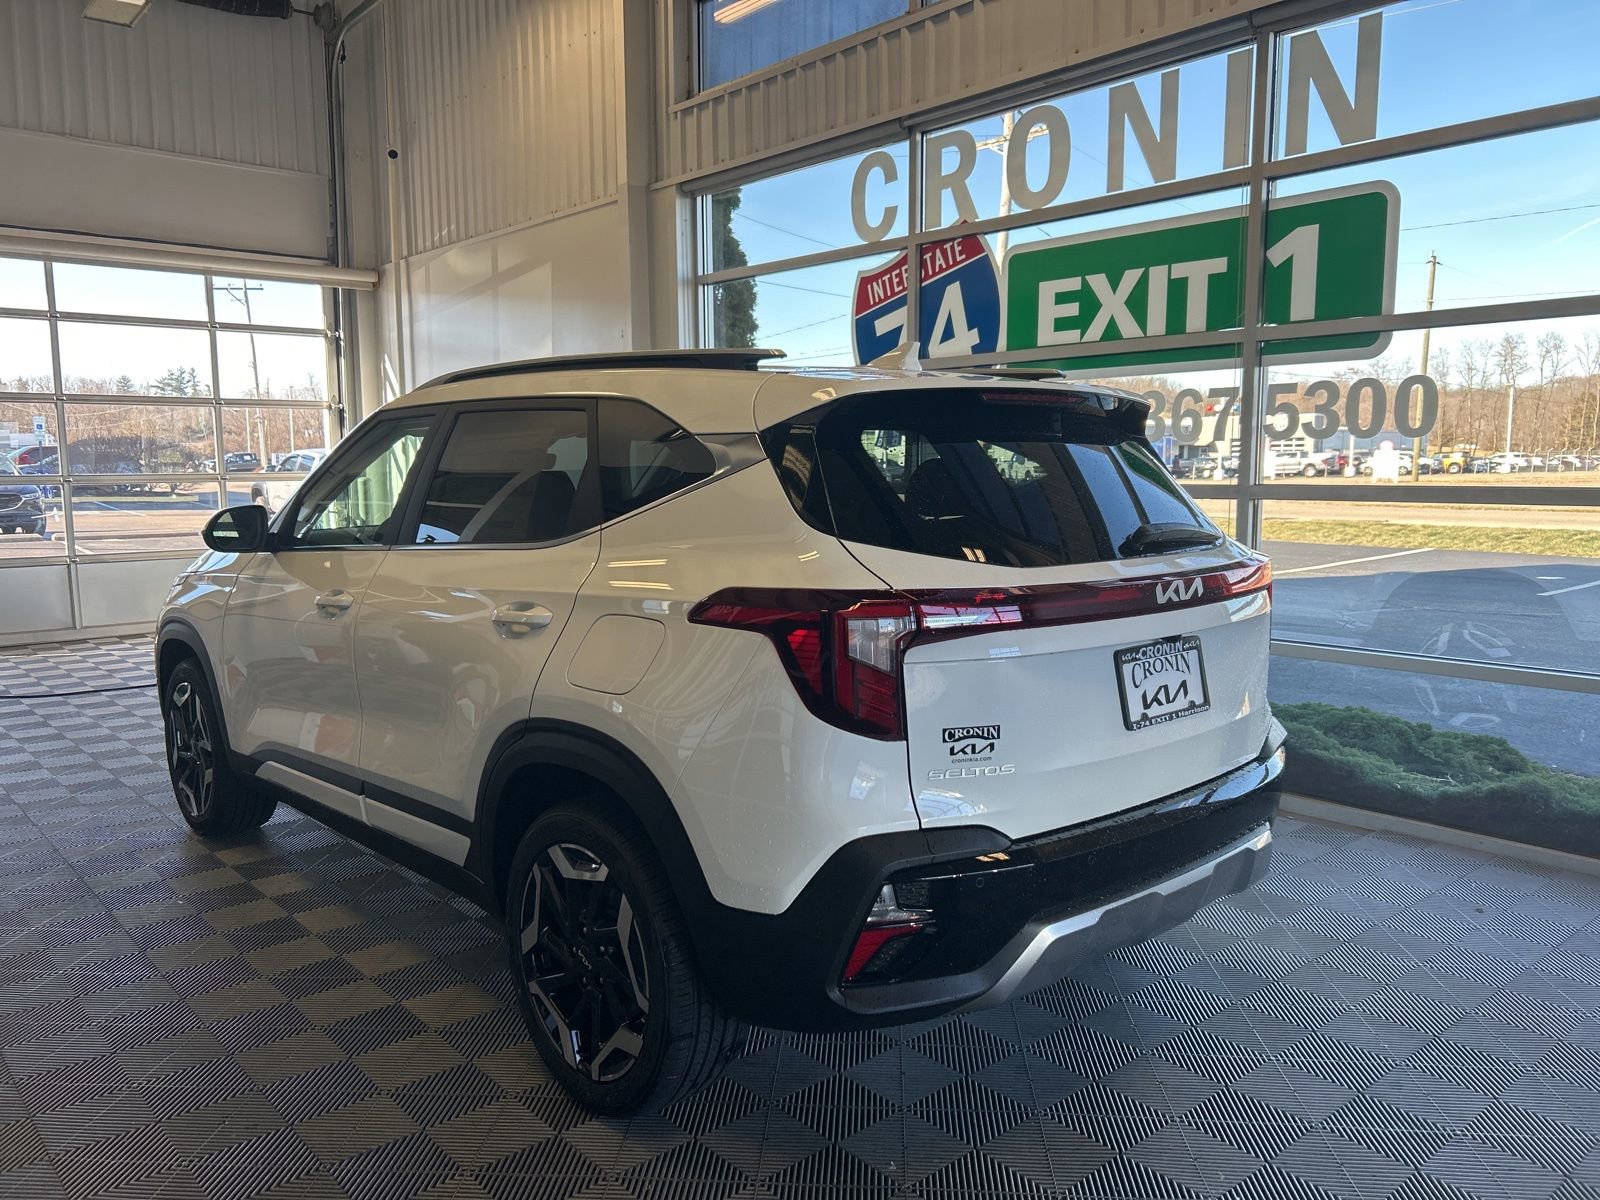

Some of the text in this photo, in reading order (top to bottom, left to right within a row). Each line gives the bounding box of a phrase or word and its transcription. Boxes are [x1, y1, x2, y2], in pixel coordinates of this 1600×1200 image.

[851, 11, 1383, 243] CRONIN
[1037, 223, 1320, 347] EXIT 1
[1263, 374, 1439, 440] 5300
[1155, 576, 1204, 605] KIA
[1139, 640, 1183, 660] CRONIN
[1131, 651, 1191, 689] CRONIN
[1141, 679, 1189, 711] KIA
[1178, 705, 1210, 718] Harrison
[944, 726, 999, 742] CRONIN
[949, 742, 995, 756] KIA
[951, 756, 993, 764] croninkia.com
[927, 764, 1016, 780] SELTOS
